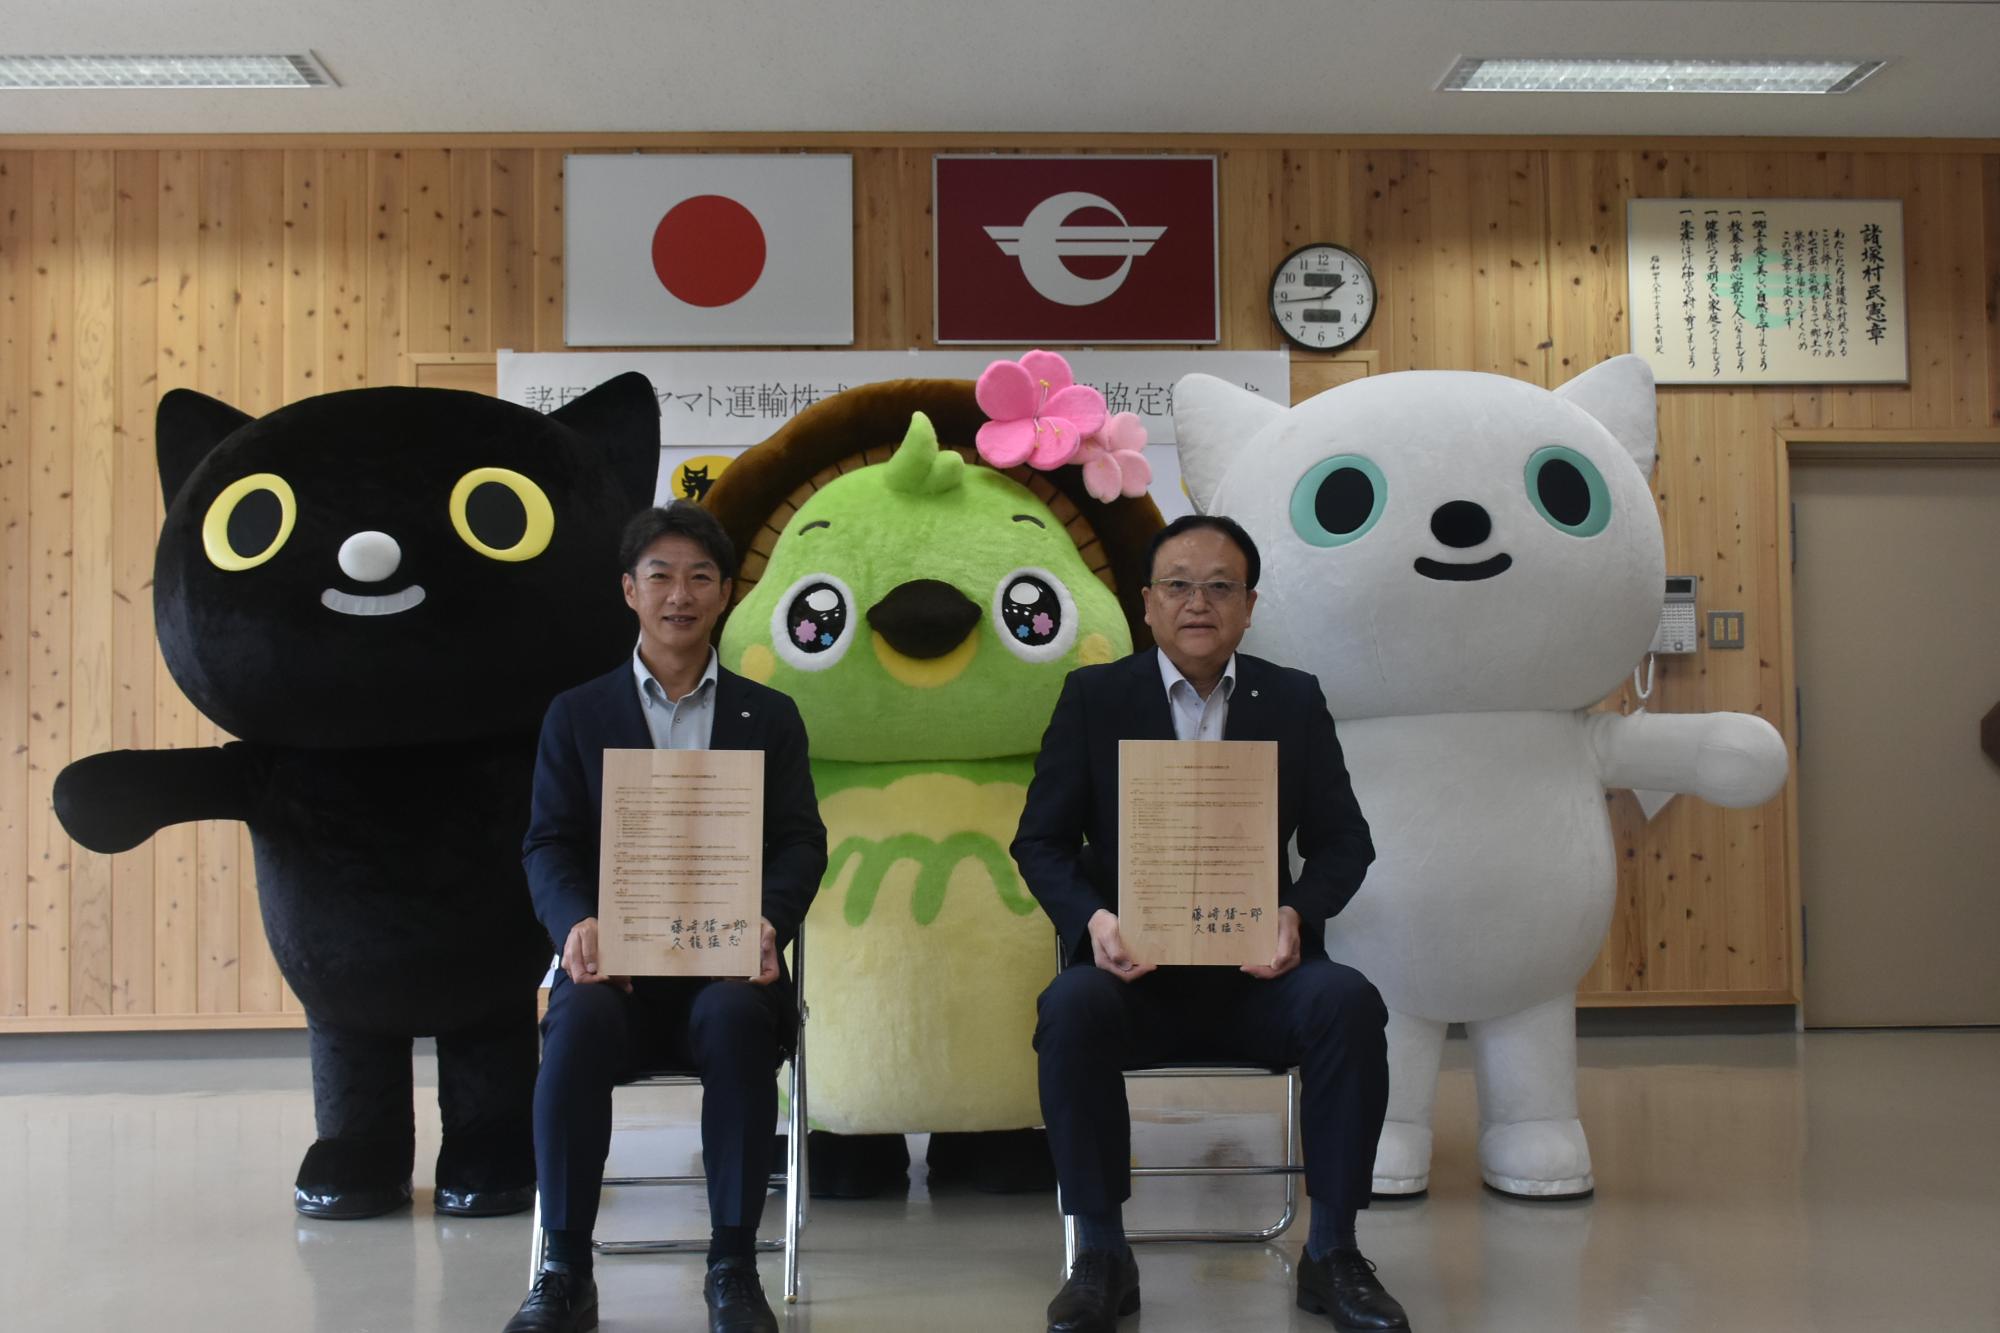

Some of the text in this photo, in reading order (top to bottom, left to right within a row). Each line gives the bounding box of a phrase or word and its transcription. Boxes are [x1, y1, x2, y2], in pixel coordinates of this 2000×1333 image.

[1300, 259, 1308, 270] 11
[1317, 254, 1329, 265] 12
[1340, 261, 1344, 271] 1
[1285, 272, 1295, 283] 10
[1352, 275, 1359, 285] 2
[1860, 224, 1887, 345] 諸塚村民憲章
[1280, 292, 1288, 303] 9
[1357, 295, 1364, 305] 3
[1285, 312, 1292, 320] 8
[1351, 313, 1357, 324] 4
[1299, 326, 1306, 337] 7
[1317, 332, 1325, 342] 6
[1337, 327, 1344, 337] 5
[653, 382, 848, 419] ヤマト運輸株
